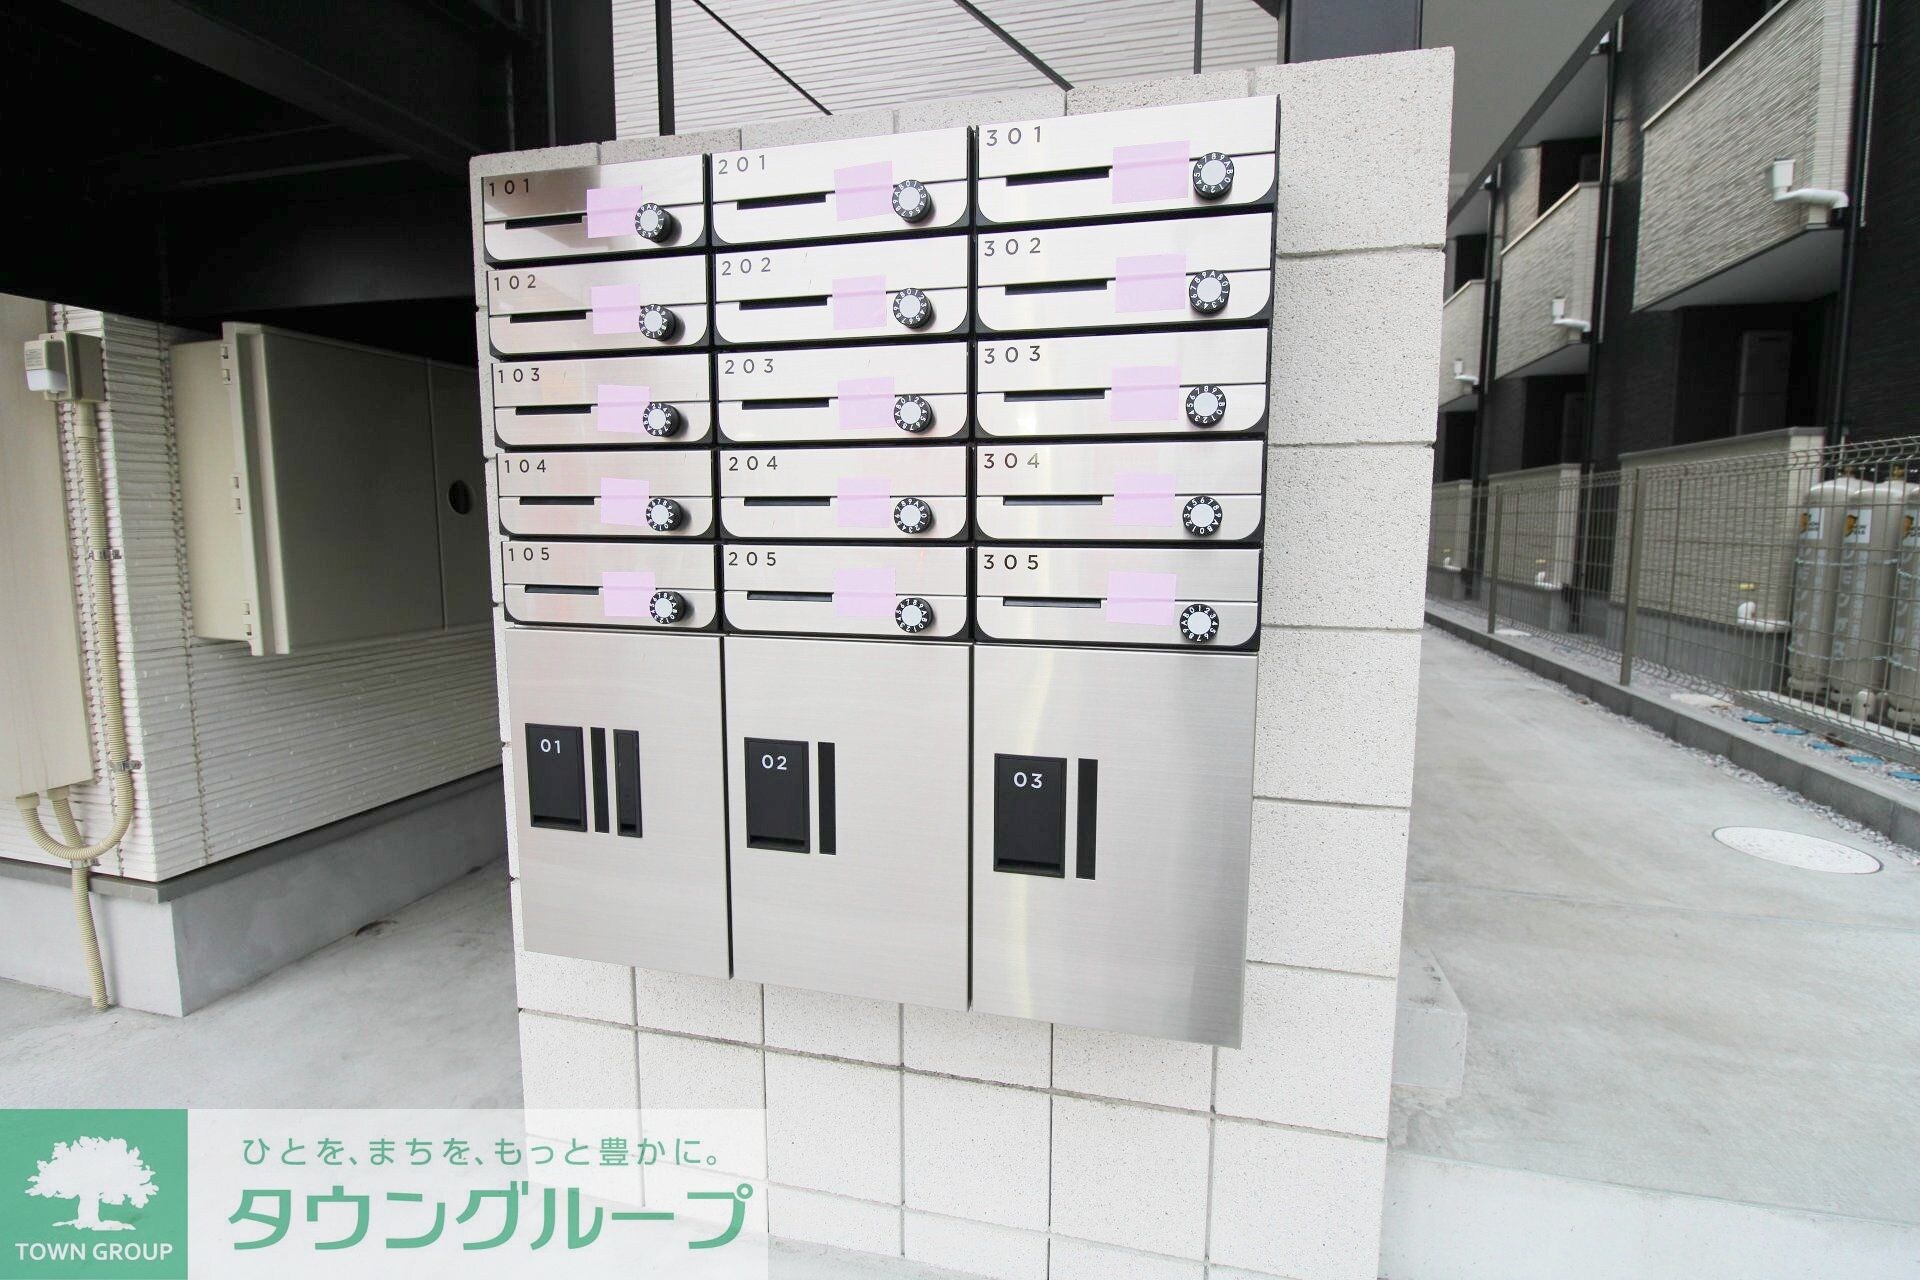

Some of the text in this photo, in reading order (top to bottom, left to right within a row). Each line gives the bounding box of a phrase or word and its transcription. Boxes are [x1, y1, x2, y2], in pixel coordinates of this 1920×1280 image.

[986, 126, 1042, 147] 301
[718, 154, 766, 175] 201
[488, 178, 530, 197] 101
[984, 236, 1042, 257] 302
[721, 257, 772, 276] 202
[494, 274, 537, 292] 102
[984, 345, 1041, 364] 303
[498, 367, 541, 384] 103
[724, 358, 775, 375] 203
[505, 458, 547, 474] 104
[728, 455, 779, 472] 204
[983, 452, 1040, 470] 304
[508, 547, 550, 562] 105
[728, 551, 777, 567] 205
[983, 553, 1039, 571] 305
[540, 738, 561, 754] 01
[761, 754, 788, 771] 02
[1013, 771, 1043, 789] 03
